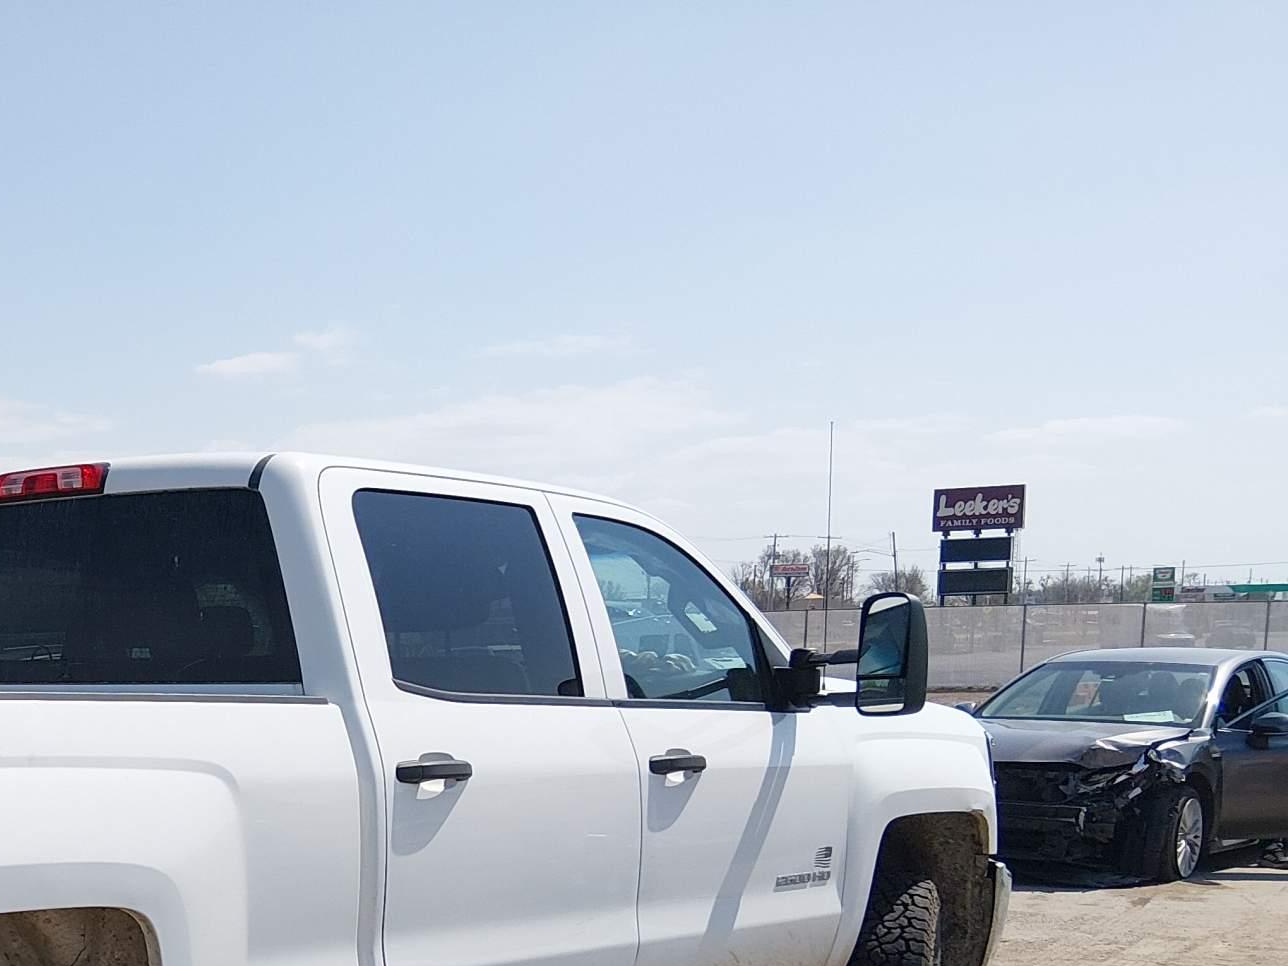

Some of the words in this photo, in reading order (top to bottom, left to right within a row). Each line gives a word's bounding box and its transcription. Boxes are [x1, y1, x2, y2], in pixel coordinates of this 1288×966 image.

[936, 493, 1021, 517] Leeker's
[940, 518, 978, 527] FAMILY
[980, 517, 1015, 525] FOODS
